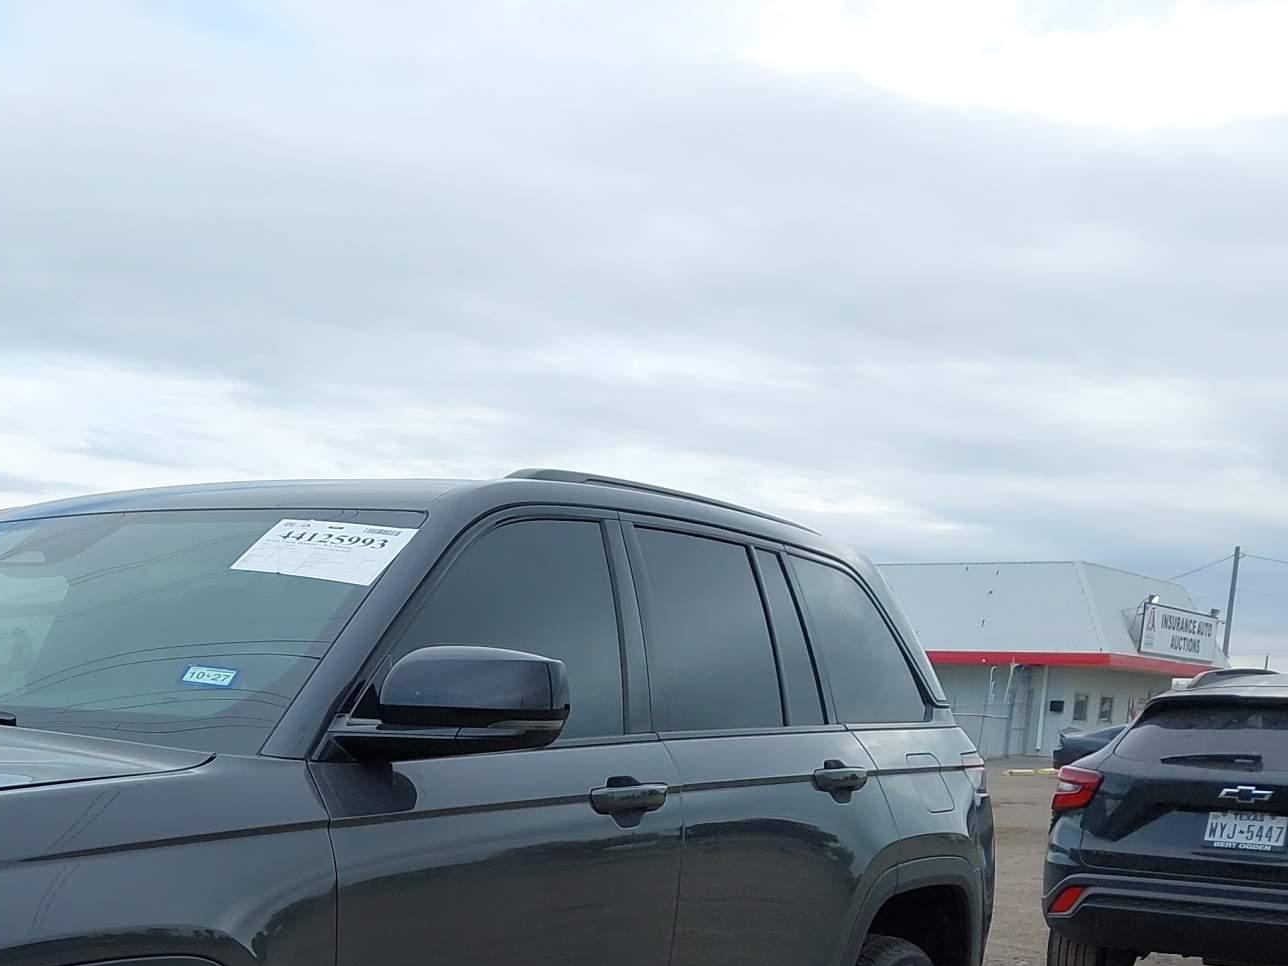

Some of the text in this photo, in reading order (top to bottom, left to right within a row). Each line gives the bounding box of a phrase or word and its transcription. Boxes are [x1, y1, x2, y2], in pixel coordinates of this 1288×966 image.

[279, 530, 389, 550] 44125993
[1161, 614, 1197, 634] INSURANCE
[1197, 621, 1212, 637] AUTO
[1170, 637, 1200, 653] AUCTIONS
[1234, 814, 1265, 822] TEXAS
